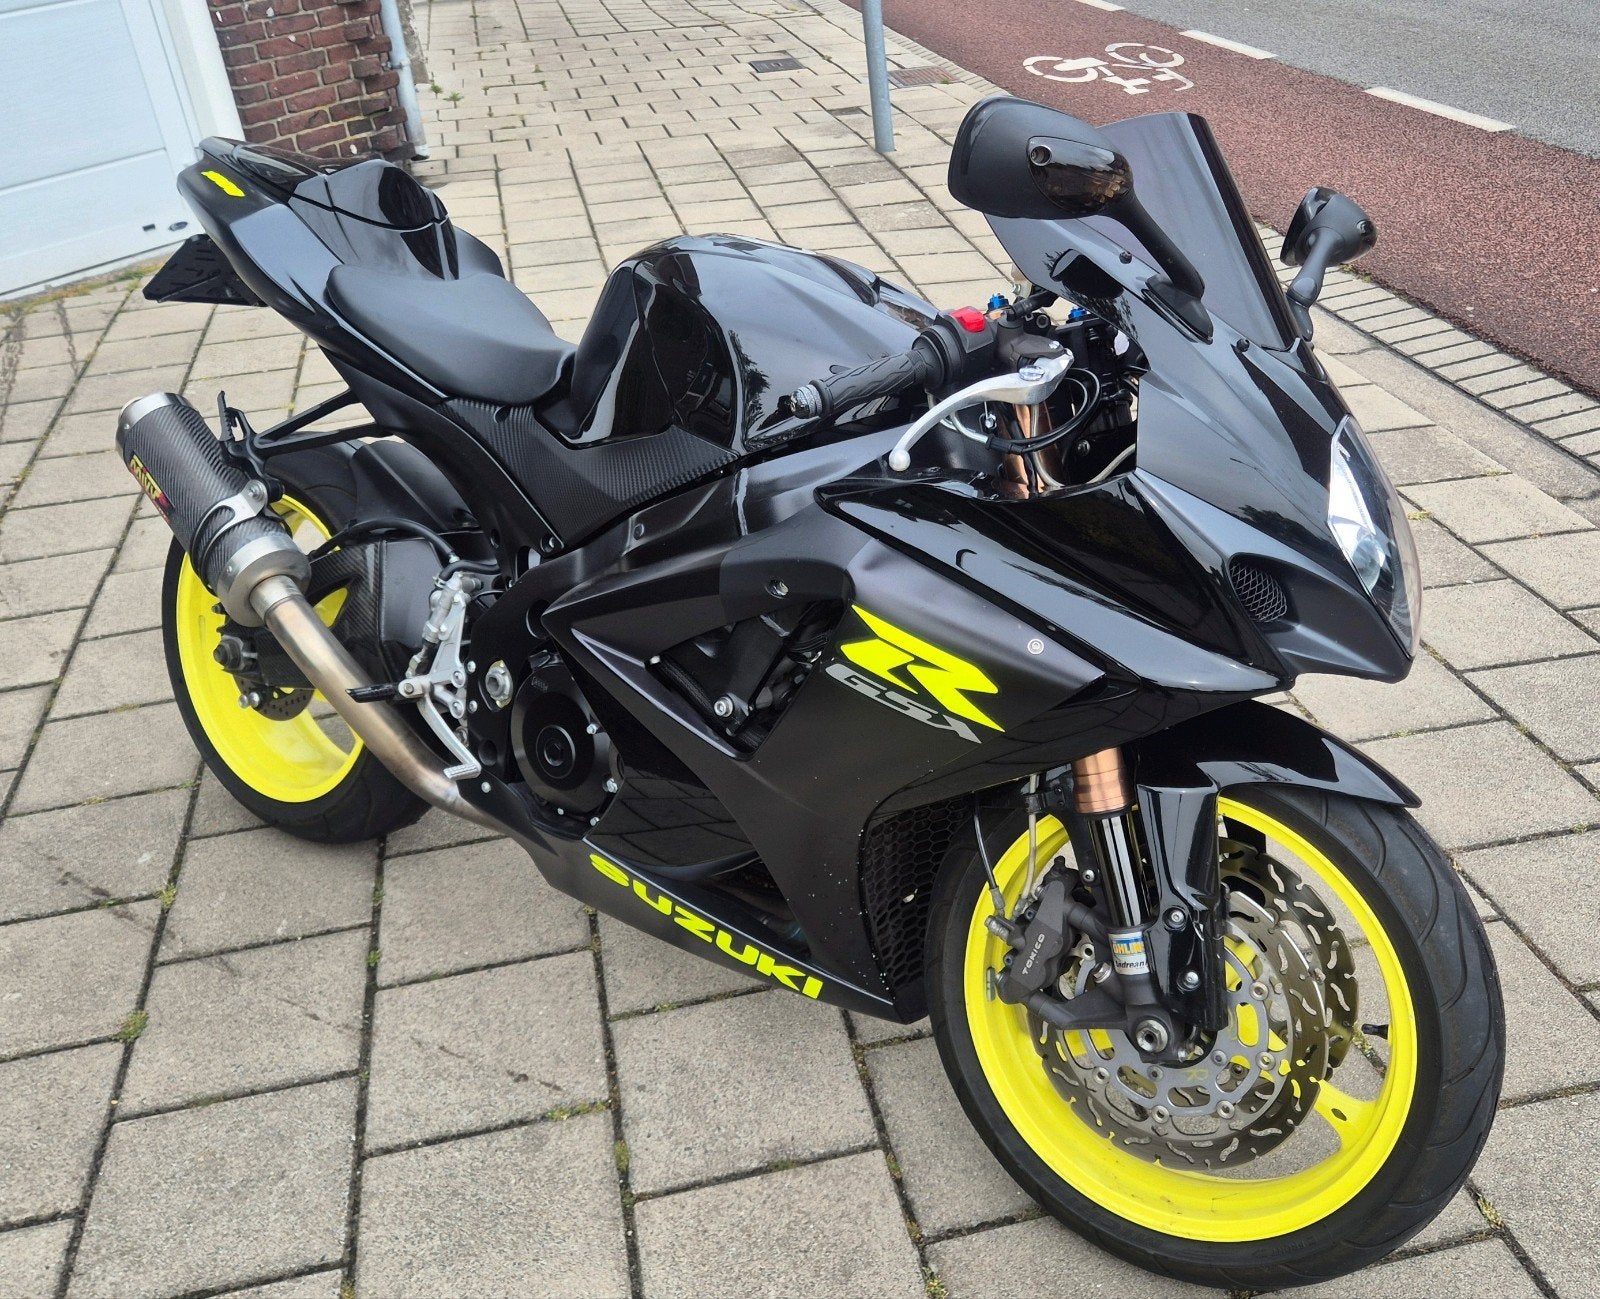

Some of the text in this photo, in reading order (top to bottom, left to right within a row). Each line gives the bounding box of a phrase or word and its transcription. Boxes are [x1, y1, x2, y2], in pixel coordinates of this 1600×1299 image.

[825, 663, 982, 744] GSX
[841, 604, 1005, 733] R
[589, 853, 824, 1000] SUZUKI
[1022, 933, 1045, 975] TOKICO
